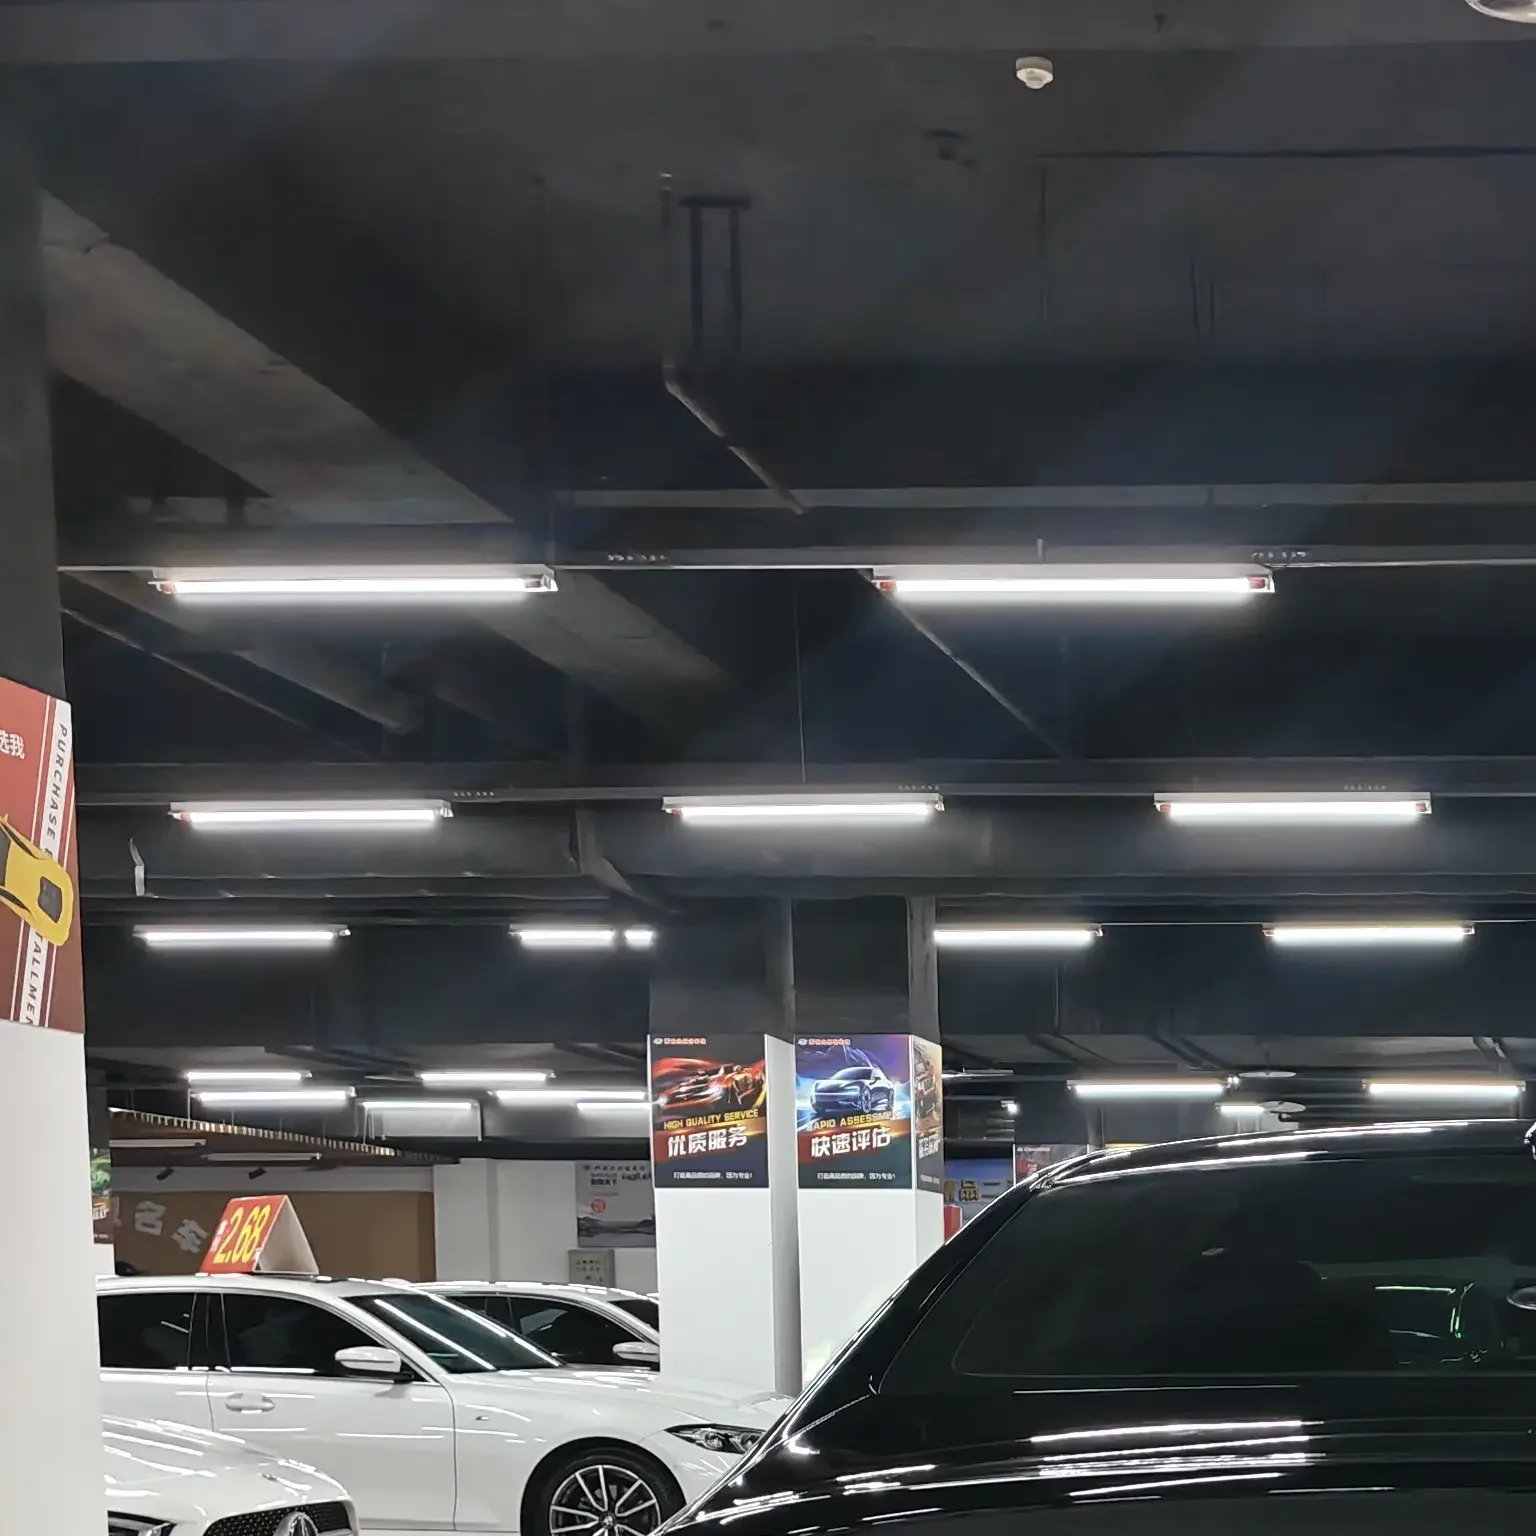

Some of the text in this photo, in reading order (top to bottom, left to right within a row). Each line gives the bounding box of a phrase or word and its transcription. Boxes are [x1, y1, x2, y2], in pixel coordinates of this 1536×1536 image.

[46, 721, 68, 841] PURCHASE
[663, 1108, 759, 1130] HIGH QUALITY SERVICE
[667, 1125, 748, 1158] 优质服务
[811, 1126, 892, 1158] 快速评估
[213, 1204, 271, 1264] 2.68
